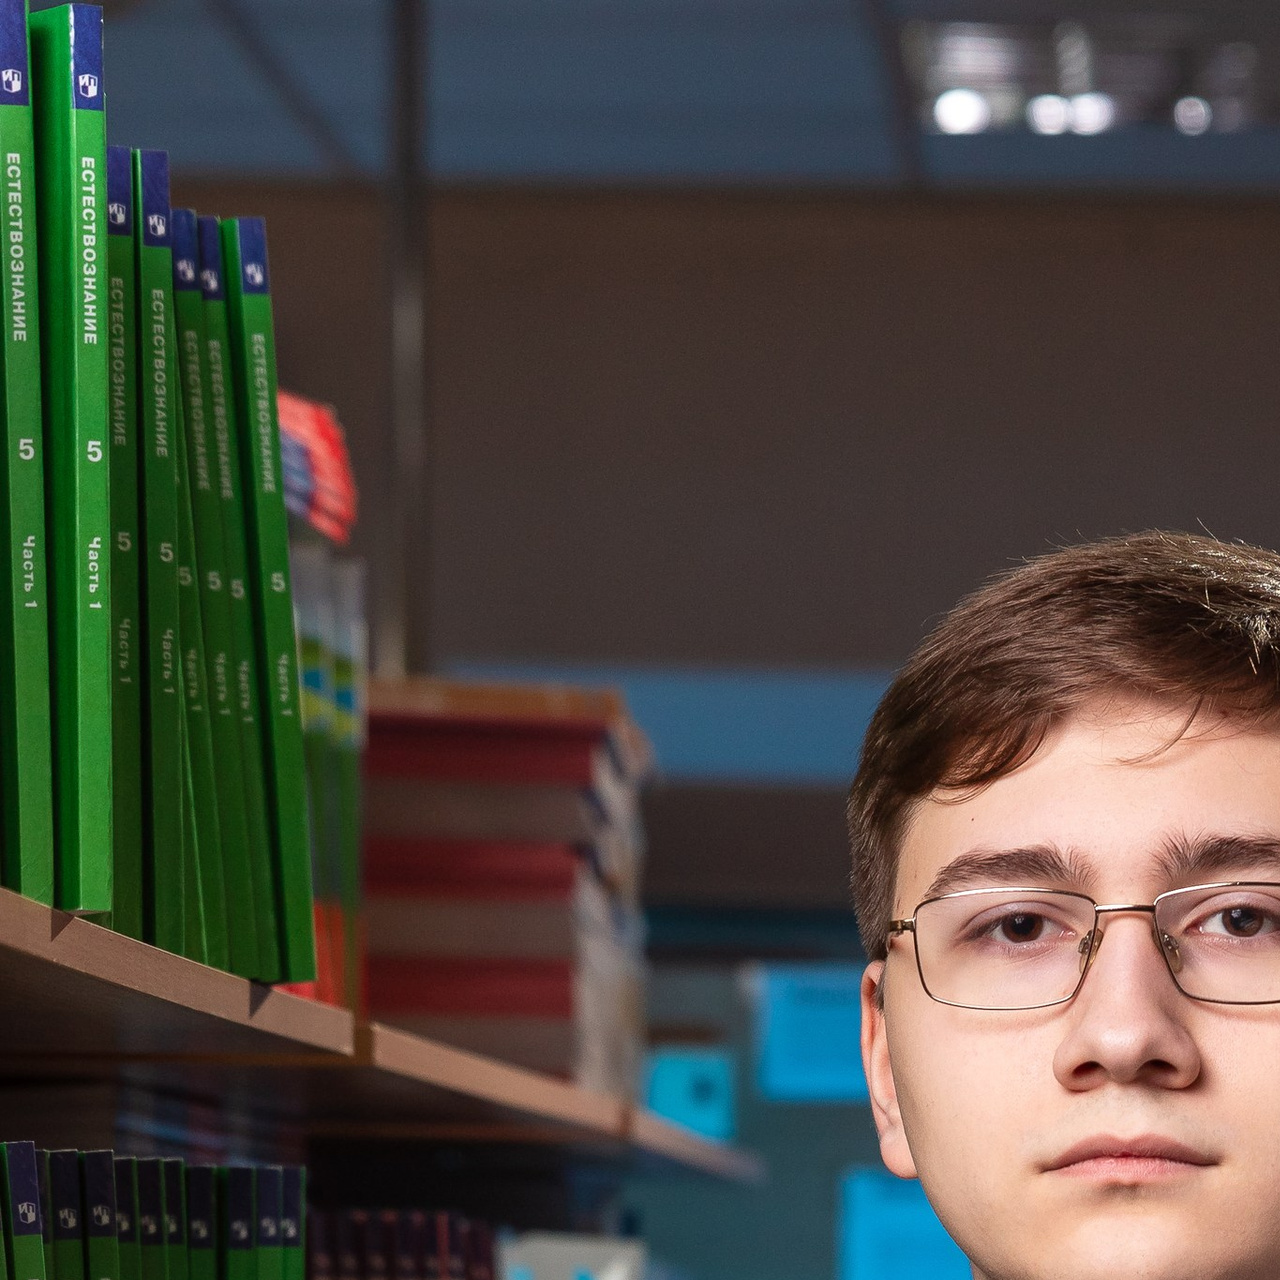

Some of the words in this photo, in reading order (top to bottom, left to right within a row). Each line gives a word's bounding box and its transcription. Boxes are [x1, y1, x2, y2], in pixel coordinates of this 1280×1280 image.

[6, 153, 27, 342] ЕСТЕСТВОЗНАНИЕ
[81, 156, 97, 345] ЕСТЕСТВОЗНАНИЕ
[111, 276, 126, 446] ЕСТЕСТВОЗНАНИЕ
[152, 288, 168, 458] ЕСТЕСТВОЗНАНИЕ
[252, 333, 276, 493] ЕСТЕСТВОЗНАНИЕ
[19, 438, 35, 461] 5
[87, 440, 103, 462] 5
[117, 532, 132, 551] 5
[160, 542, 174, 562] 5
[23, 535, 36, 592] Часть
[88, 537, 101, 593] Часть
[179, 566, 192, 586] 5
[208, 571, 222, 590] 5
[271, 572, 286, 592] 5
[231, 579, 245, 598] 5
[24, 600, 38, 608] 1
[89, 601, 102, 609] 1
[119, 618, 131, 669] Часть
[162, 629, 174, 680] Часть
